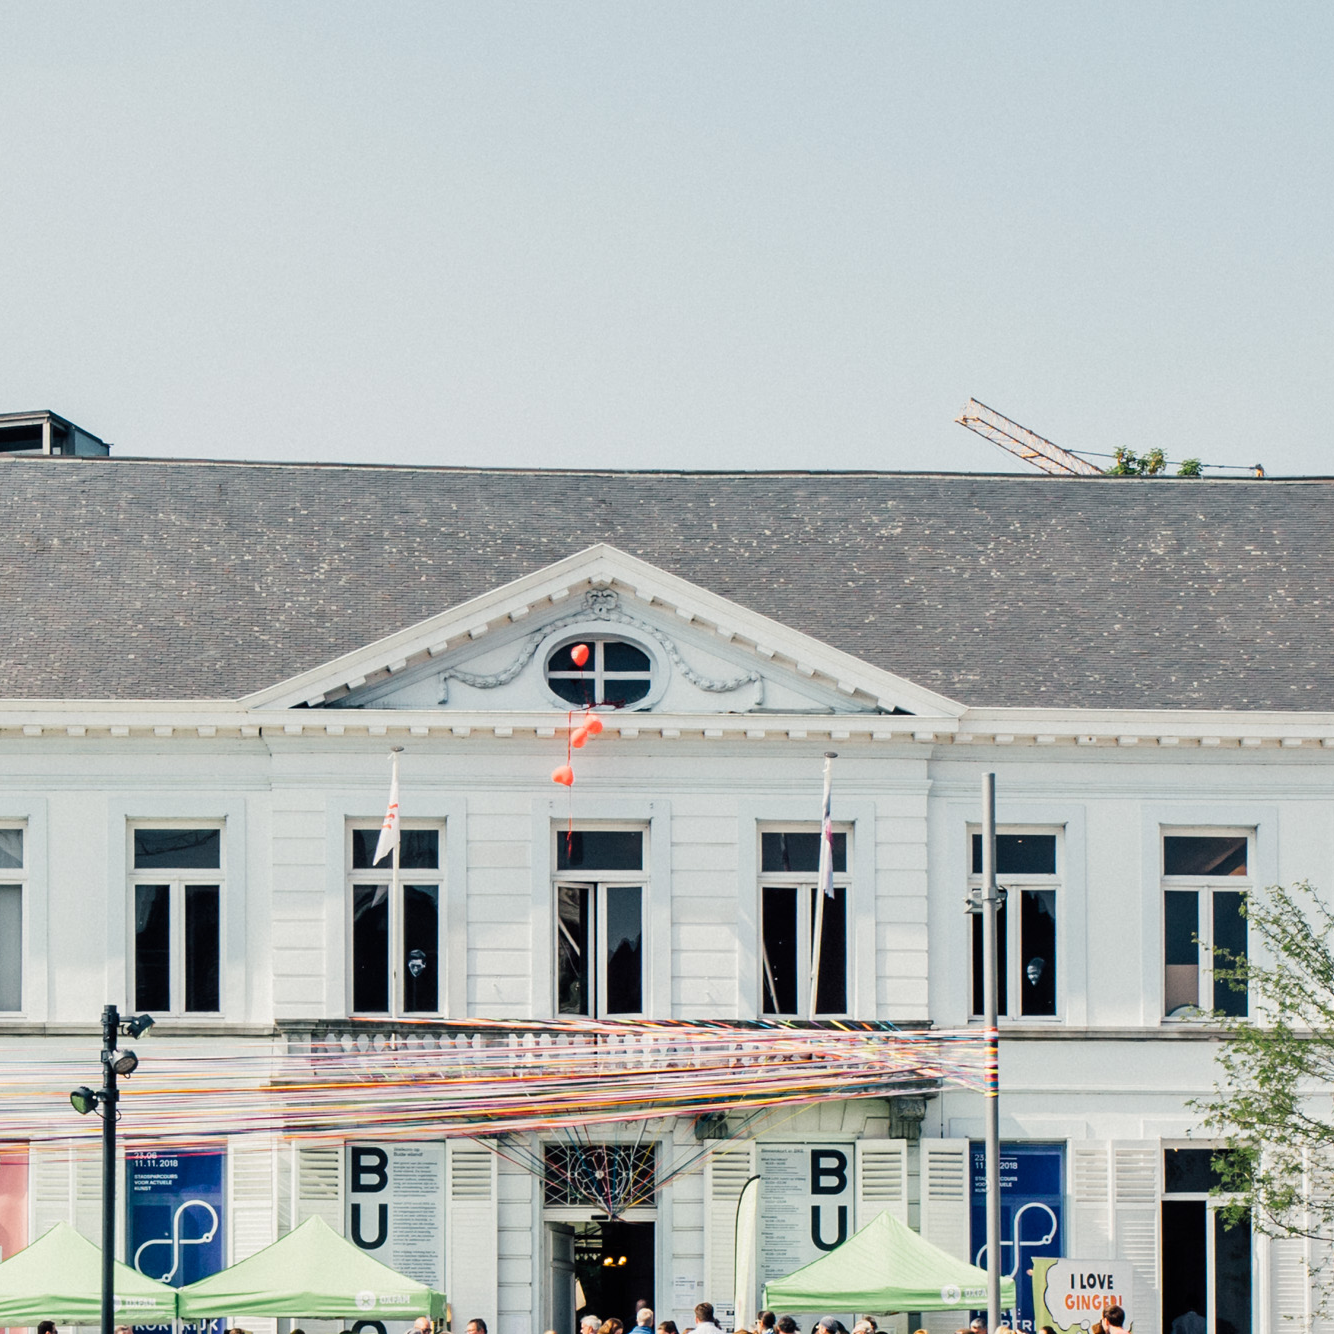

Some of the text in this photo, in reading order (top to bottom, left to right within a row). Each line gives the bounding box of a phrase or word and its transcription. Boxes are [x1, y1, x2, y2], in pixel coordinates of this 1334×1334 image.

[1070, 1273, 1114, 1289] I LOVE
[379, 1294, 411, 1304] OXFAM
